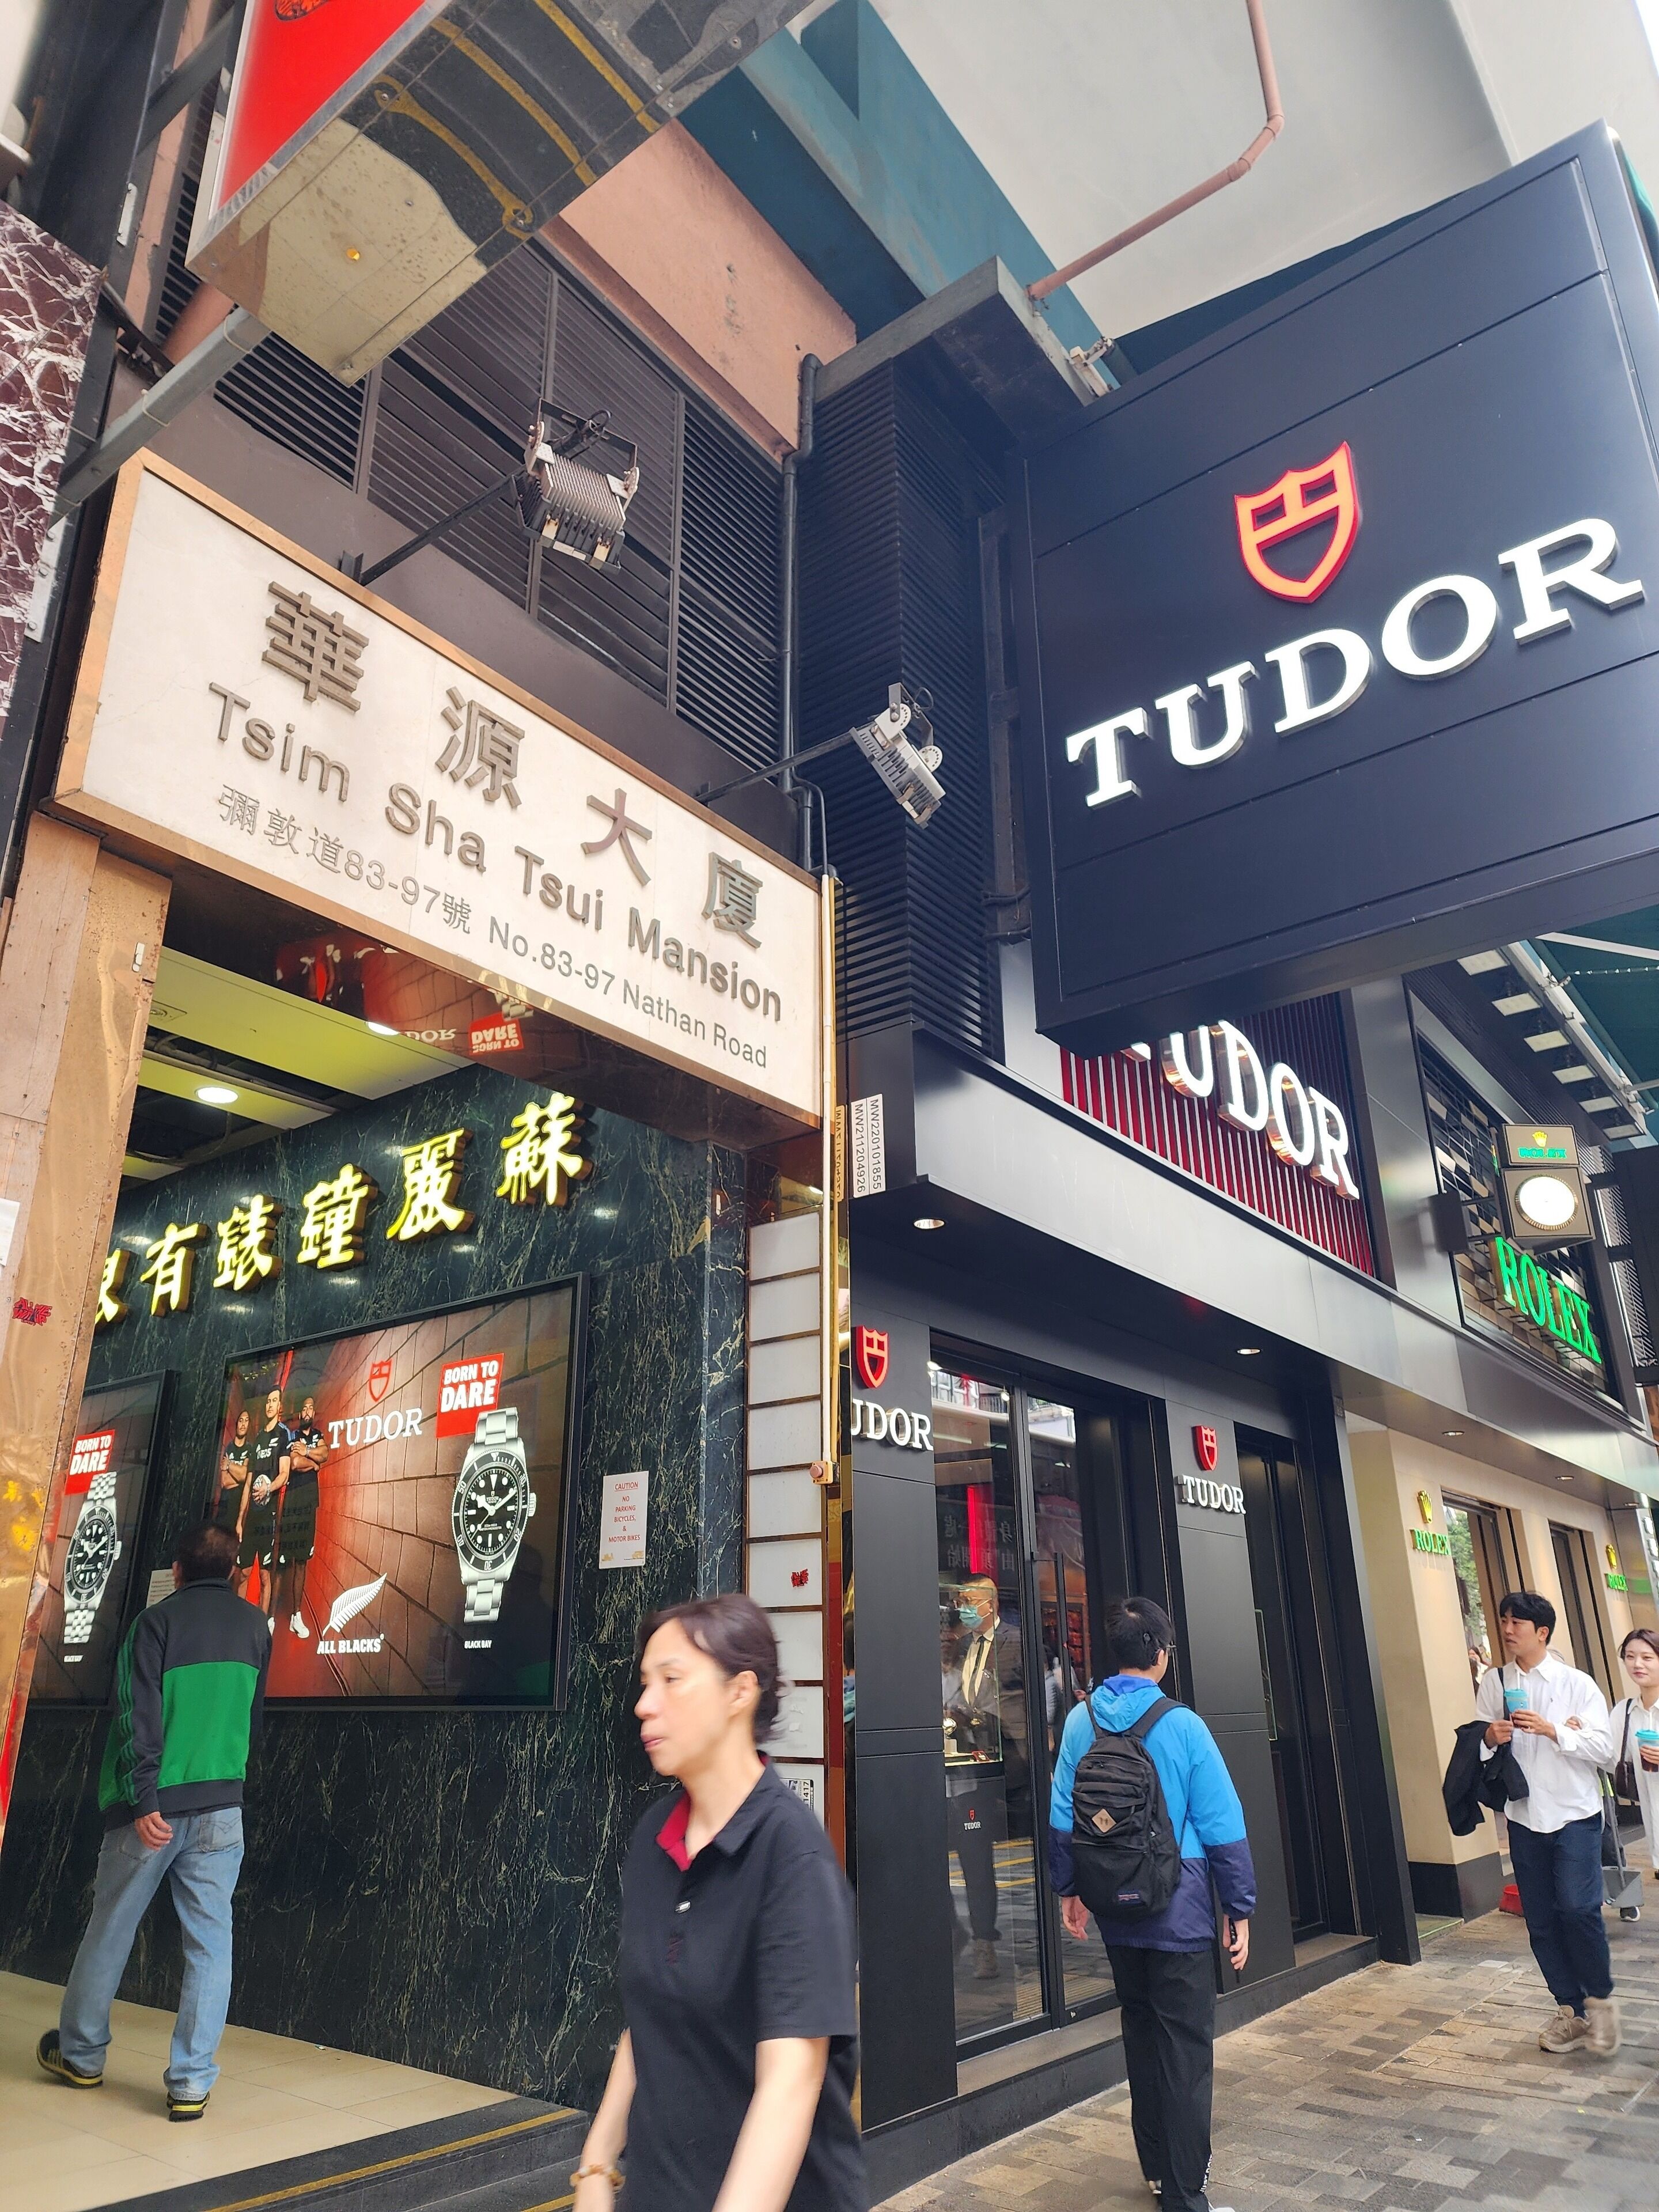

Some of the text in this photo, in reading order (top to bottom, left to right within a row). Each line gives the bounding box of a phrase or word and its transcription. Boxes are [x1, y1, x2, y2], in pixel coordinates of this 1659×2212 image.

[1066, 518, 1645, 807] TUDOR
[262, 581, 763, 949] 華源大廈
[209, 681, 782, 1022] Tsim Sha Tsui Mansion
[489, 915, 616, 996] No.83-97
[623, 979, 716, 1041] Nathan
[713, 1025, 767, 1069] Road
[1120, 1020, 1360, 1201] UDOR
[854, 1102, 866, 1194] MW211204926
[870, 1098, 881, 1190] MW220101855
[1495, 1236, 1602, 1364] ROLEX
[444, 1360, 499, 1385] BORN TO
[440, 1378, 497, 1413] DARE
[74, 1435, 112, 1454] BORN TO
[328, 1407, 423, 1449] TUDOR
[69, 1449, 110, 1476] DARE
[615, 1481, 638, 1491] CAUTION
[1179, 1474, 1247, 1514] TUDOR
[615, 1505, 636, 1513] PARKING
[1410, 1528, 1452, 1556] ROLEX
[316, 1640, 336, 1655] ALL
[464, 1639, 492, 1649] BLACK BAY
[963, 1821, 982, 1831] TUDOR
